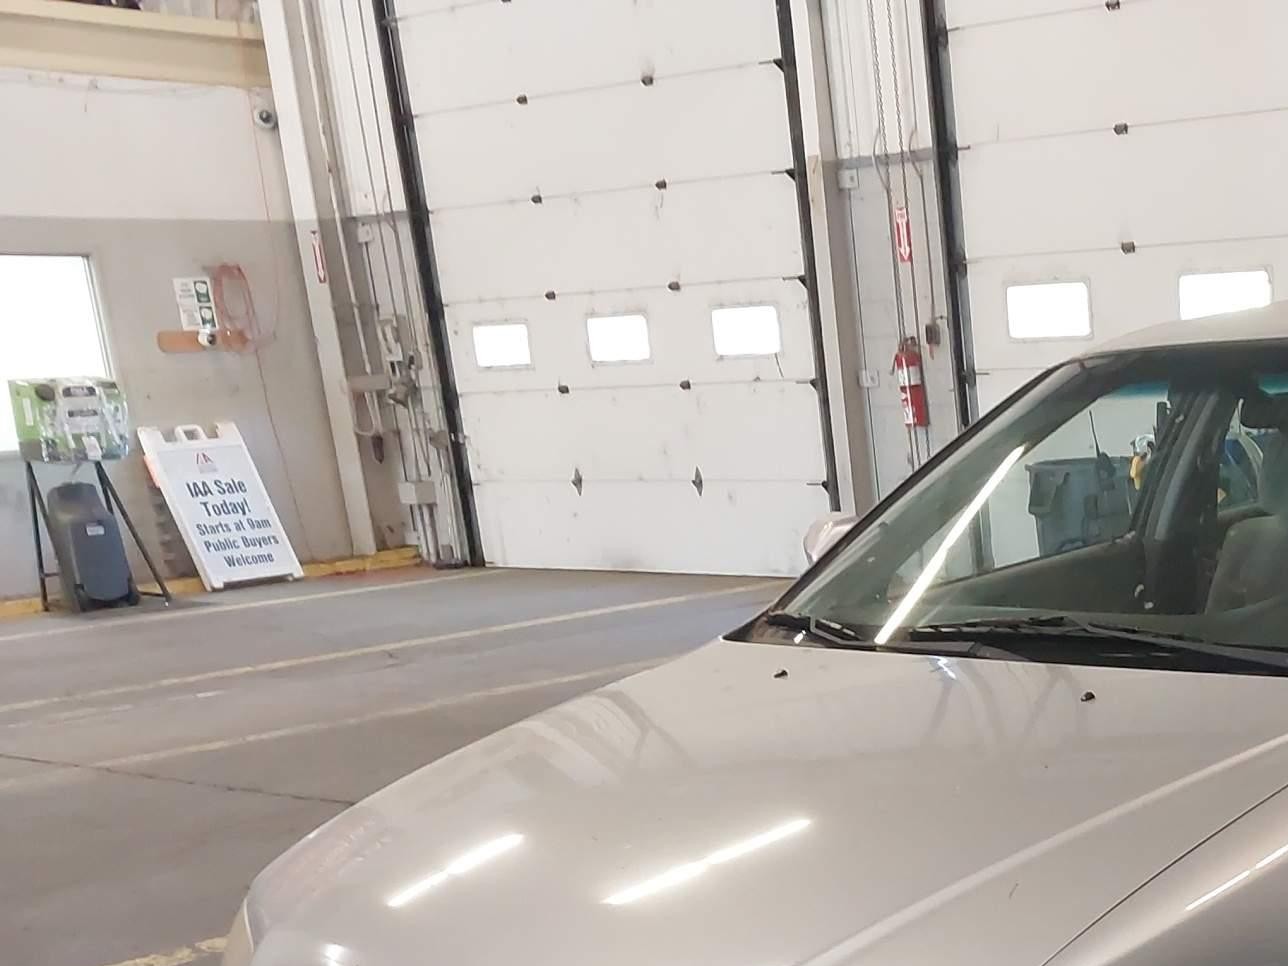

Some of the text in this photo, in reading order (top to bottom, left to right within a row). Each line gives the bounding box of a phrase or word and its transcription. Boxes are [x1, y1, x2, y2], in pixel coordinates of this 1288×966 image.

[186, 478, 248, 498] IAA Sale
[200, 498, 251, 517] Today!
[196, 522, 232, 537] Starts
[234, 519, 246, 532] at
[204, 535, 279, 553] Public Buyers
[224, 552, 275, 568] Welcome
